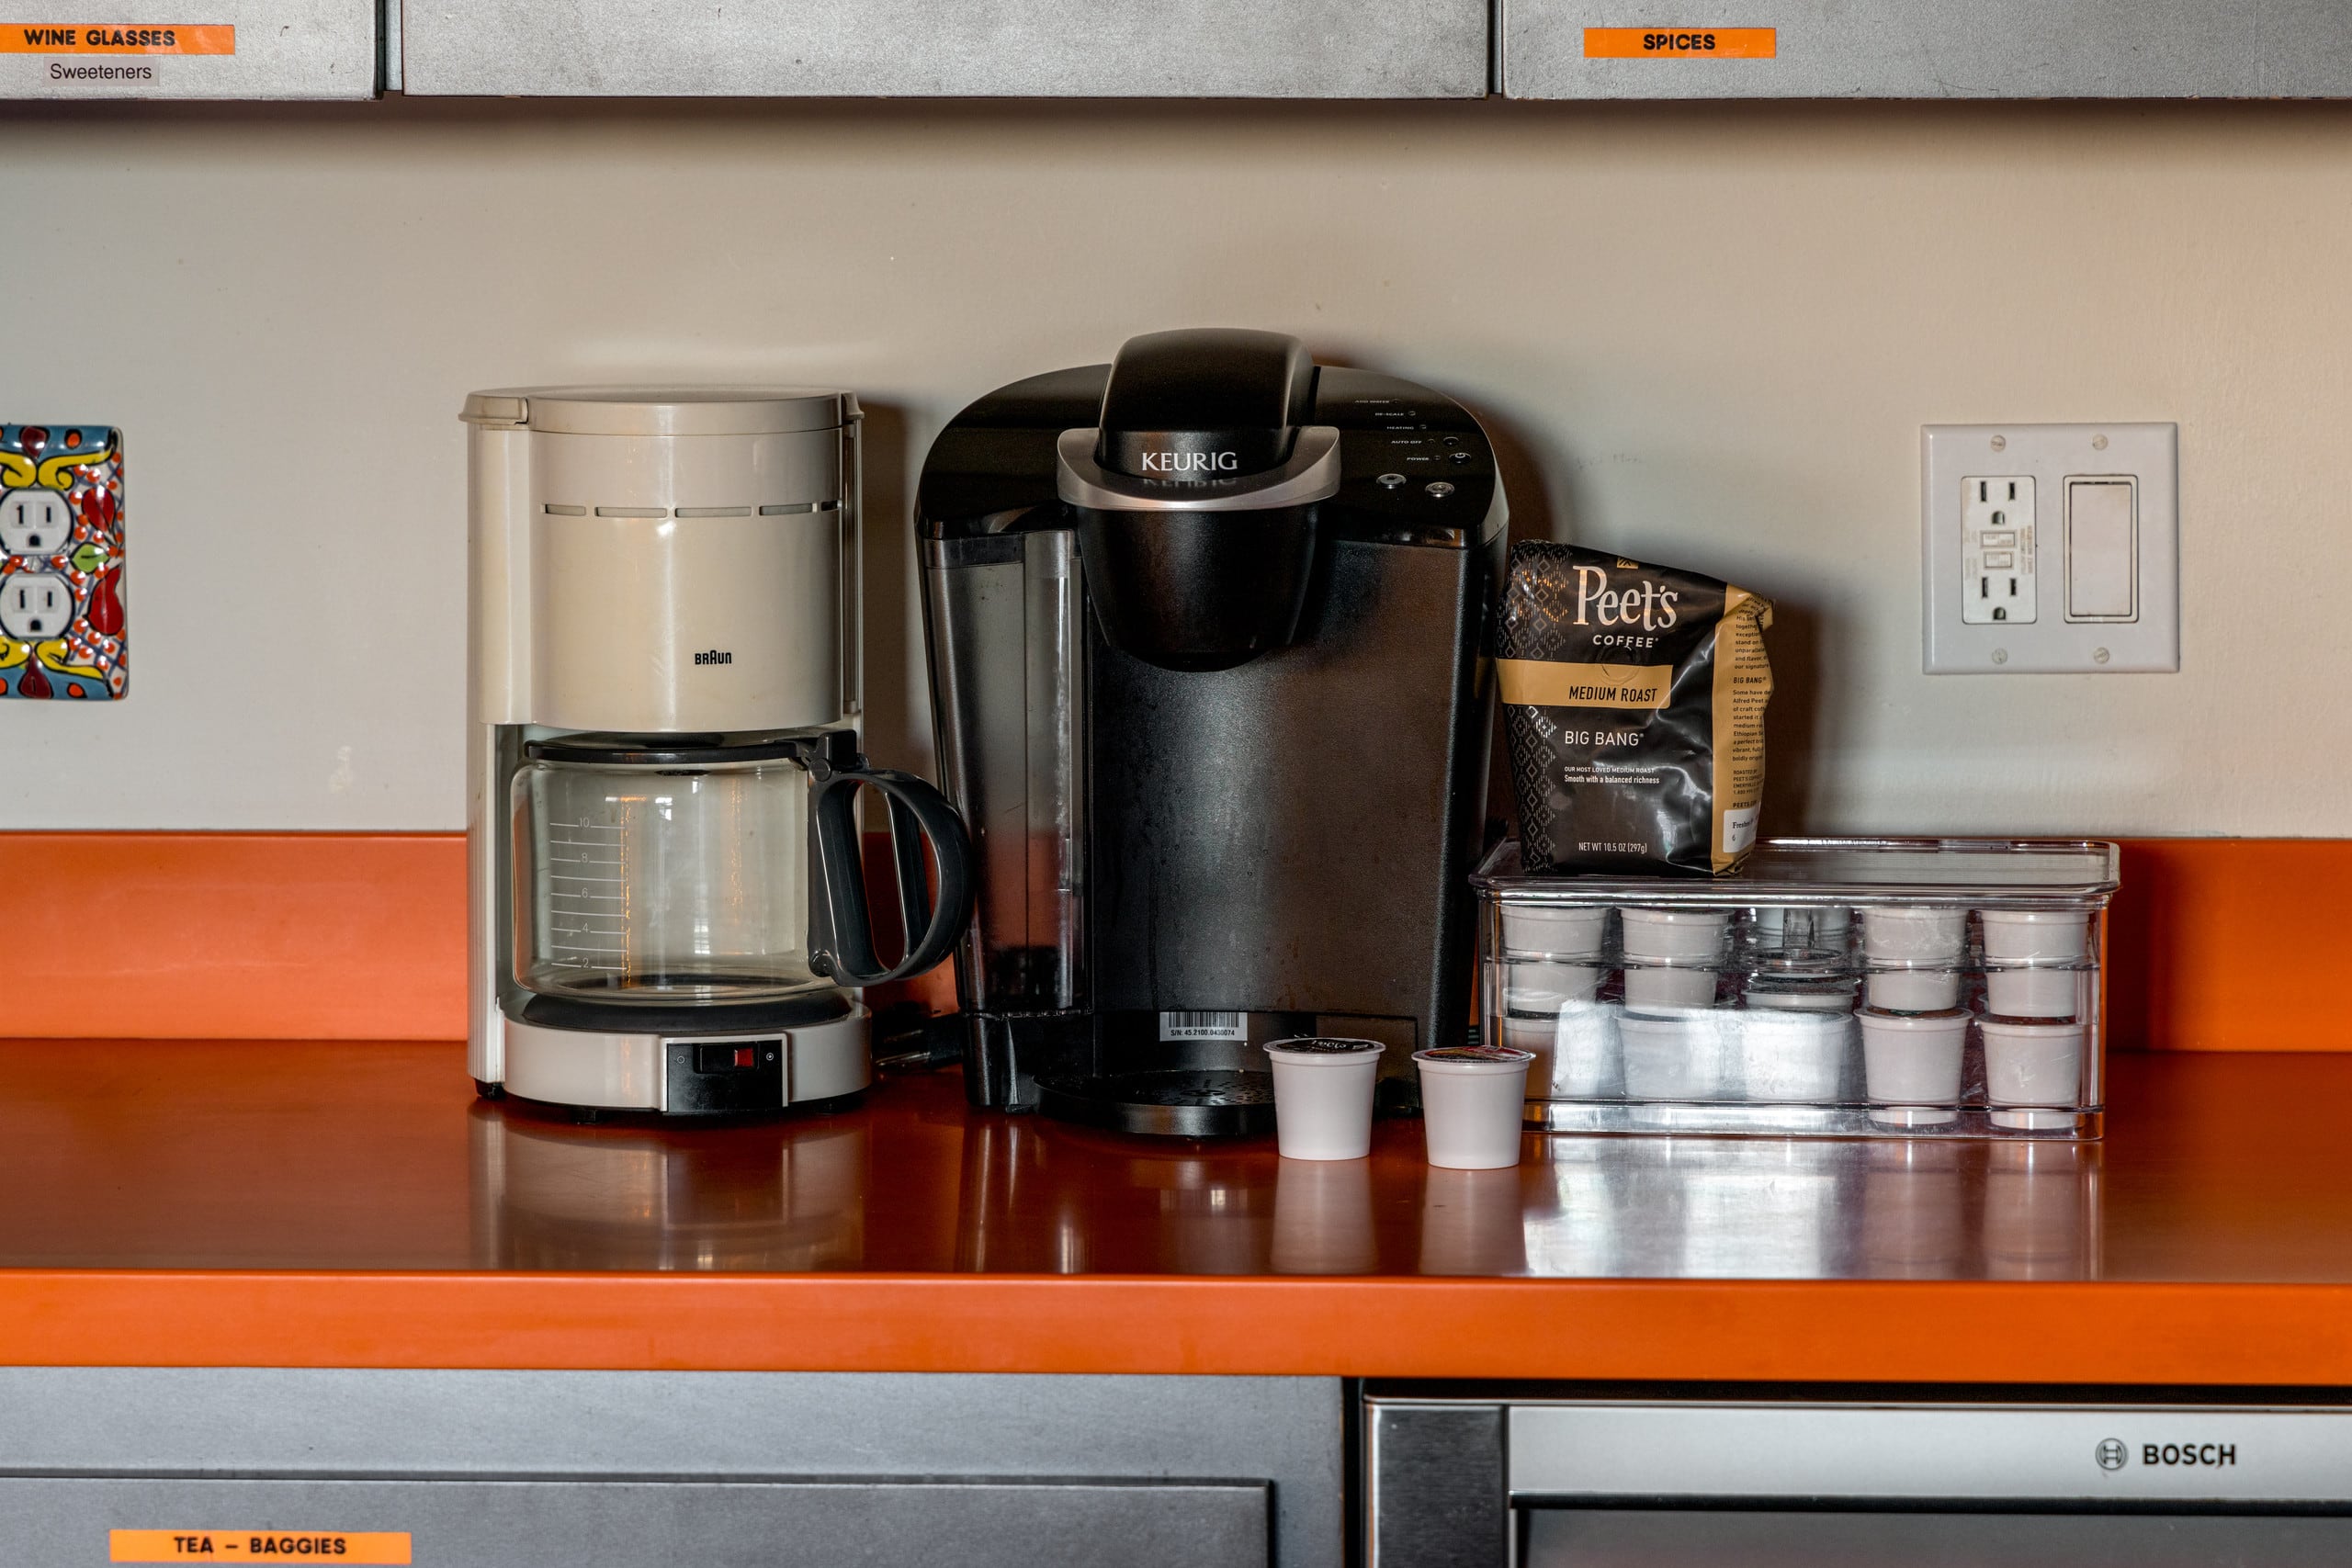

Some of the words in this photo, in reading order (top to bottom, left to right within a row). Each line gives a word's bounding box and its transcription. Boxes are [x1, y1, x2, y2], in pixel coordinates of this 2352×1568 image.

[24, 29, 76, 45] WINE
[86, 29, 175, 46] GLASSES
[1643, 34, 1715, 50] SPICES
[50, 63, 152, 79] Sweeteners
[1142, 451, 1238, 471] KEURIG
[1573, 565, 1679, 631] Peet's
[1569, 686, 1616, 700] MEDIUM
[1621, 688, 1657, 702] ROAST
[1565, 731, 1589, 745] BIG
[1564, 774, 1584, 783] Smooth
[579, 817, 589, 827] 10
[1578, 842, 1590, 851] NET
[1592, 842, 1602, 851] WT
[1604, 843, 1617, 852] 10.5
[1618, 843, 1626, 852] OZ
[1628, 843, 1647, 854] (297g)
[582, 852, 588, 863] 8
[582, 888, 588, 898] 6
[582, 923, 589, 933] 4
[583, 958, 589, 968] 2
[2143, 1444, 2235, 1465] BOSCH
[174, 1537, 213, 1553] TEA
[250, 1538, 346, 1554] BAGGIES
